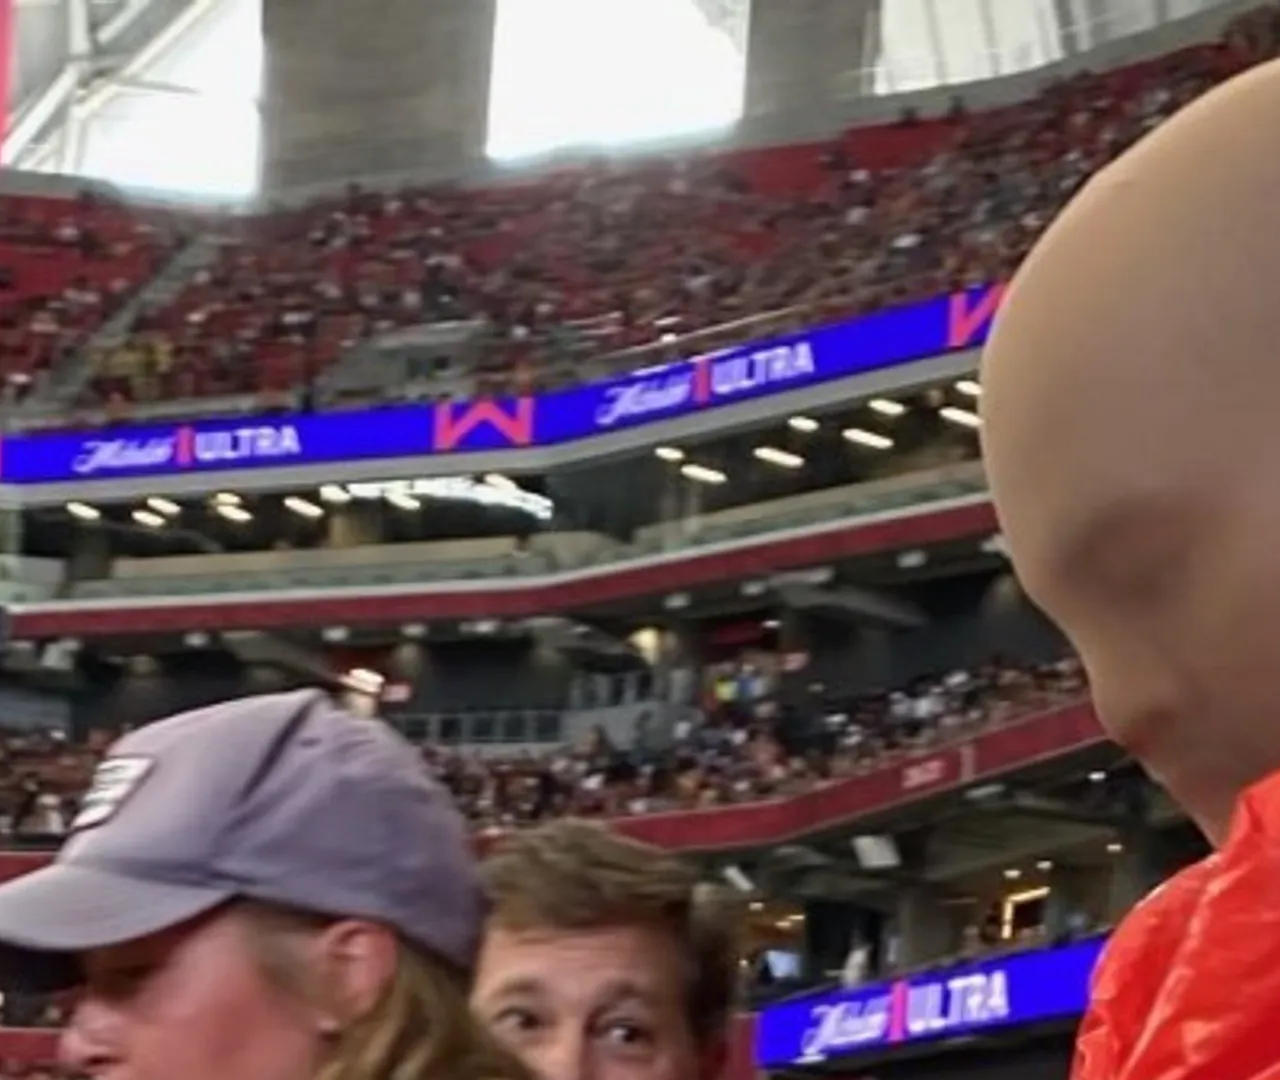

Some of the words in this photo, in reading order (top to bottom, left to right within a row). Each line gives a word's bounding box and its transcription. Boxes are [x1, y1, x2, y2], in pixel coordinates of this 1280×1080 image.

[712, 342, 815, 394] ULTRA
[195, 426, 301, 461] ULTRA
[907, 971, 1010, 1033] ULTRA
